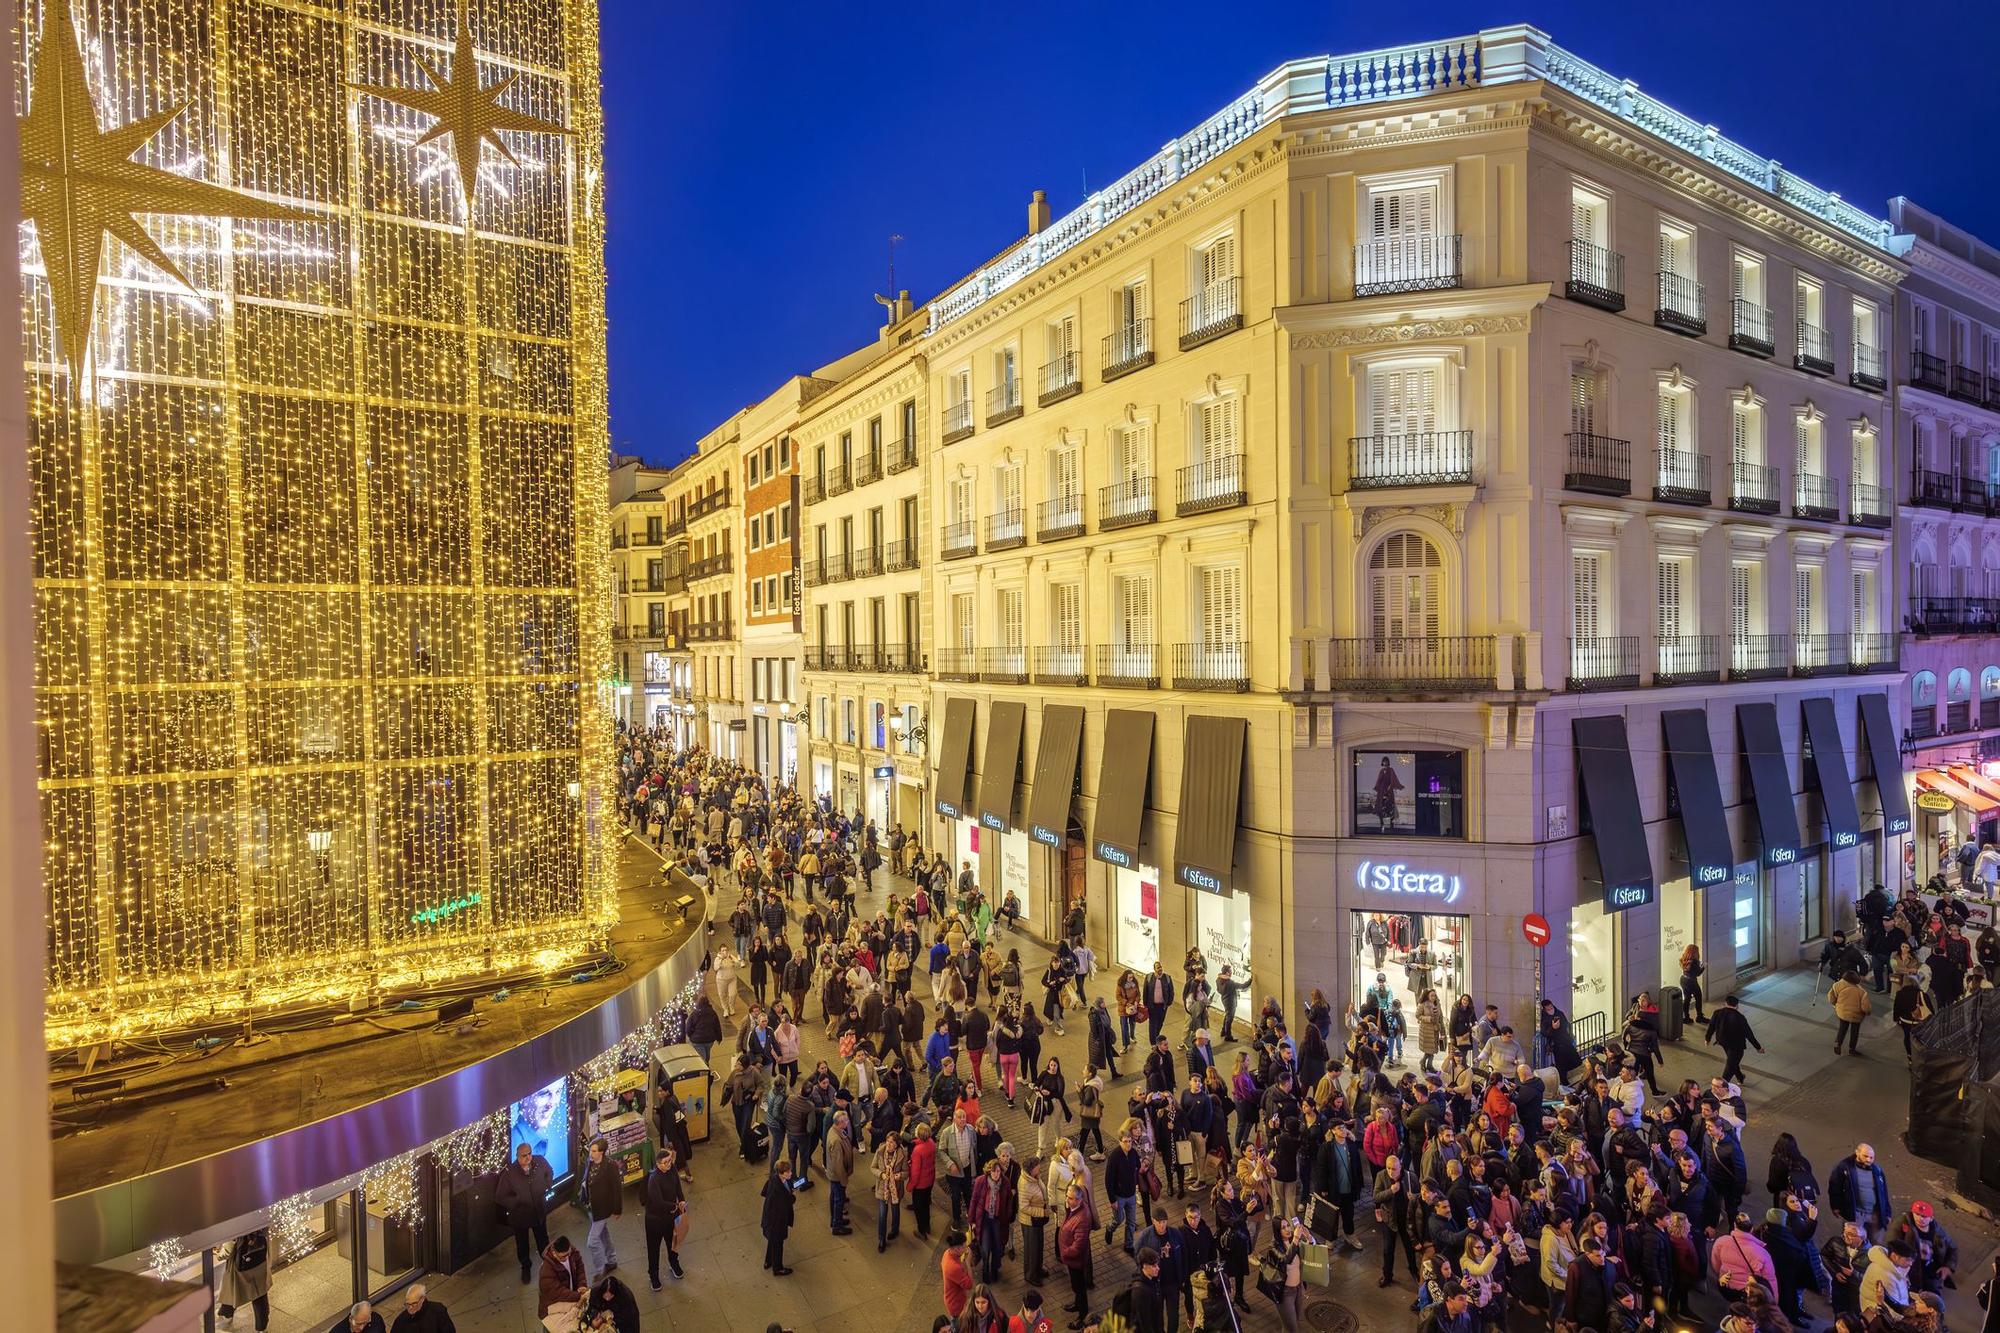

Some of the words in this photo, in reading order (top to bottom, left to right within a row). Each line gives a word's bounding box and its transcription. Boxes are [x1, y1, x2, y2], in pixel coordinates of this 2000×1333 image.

[792, 566, 800, 595] Locker
[793, 597, 801, 616] Foot
[1100, 843, 1130, 867] (Sfera)
[1183, 866, 1220, 893] (Sfera)
[1357, 861, 1461, 903] (Sfera)
[1700, 866, 1727, 881] (Sfera)
[1614, 888, 1645, 905] (Sfera)
[618, 1081, 636, 1091] ONCE
